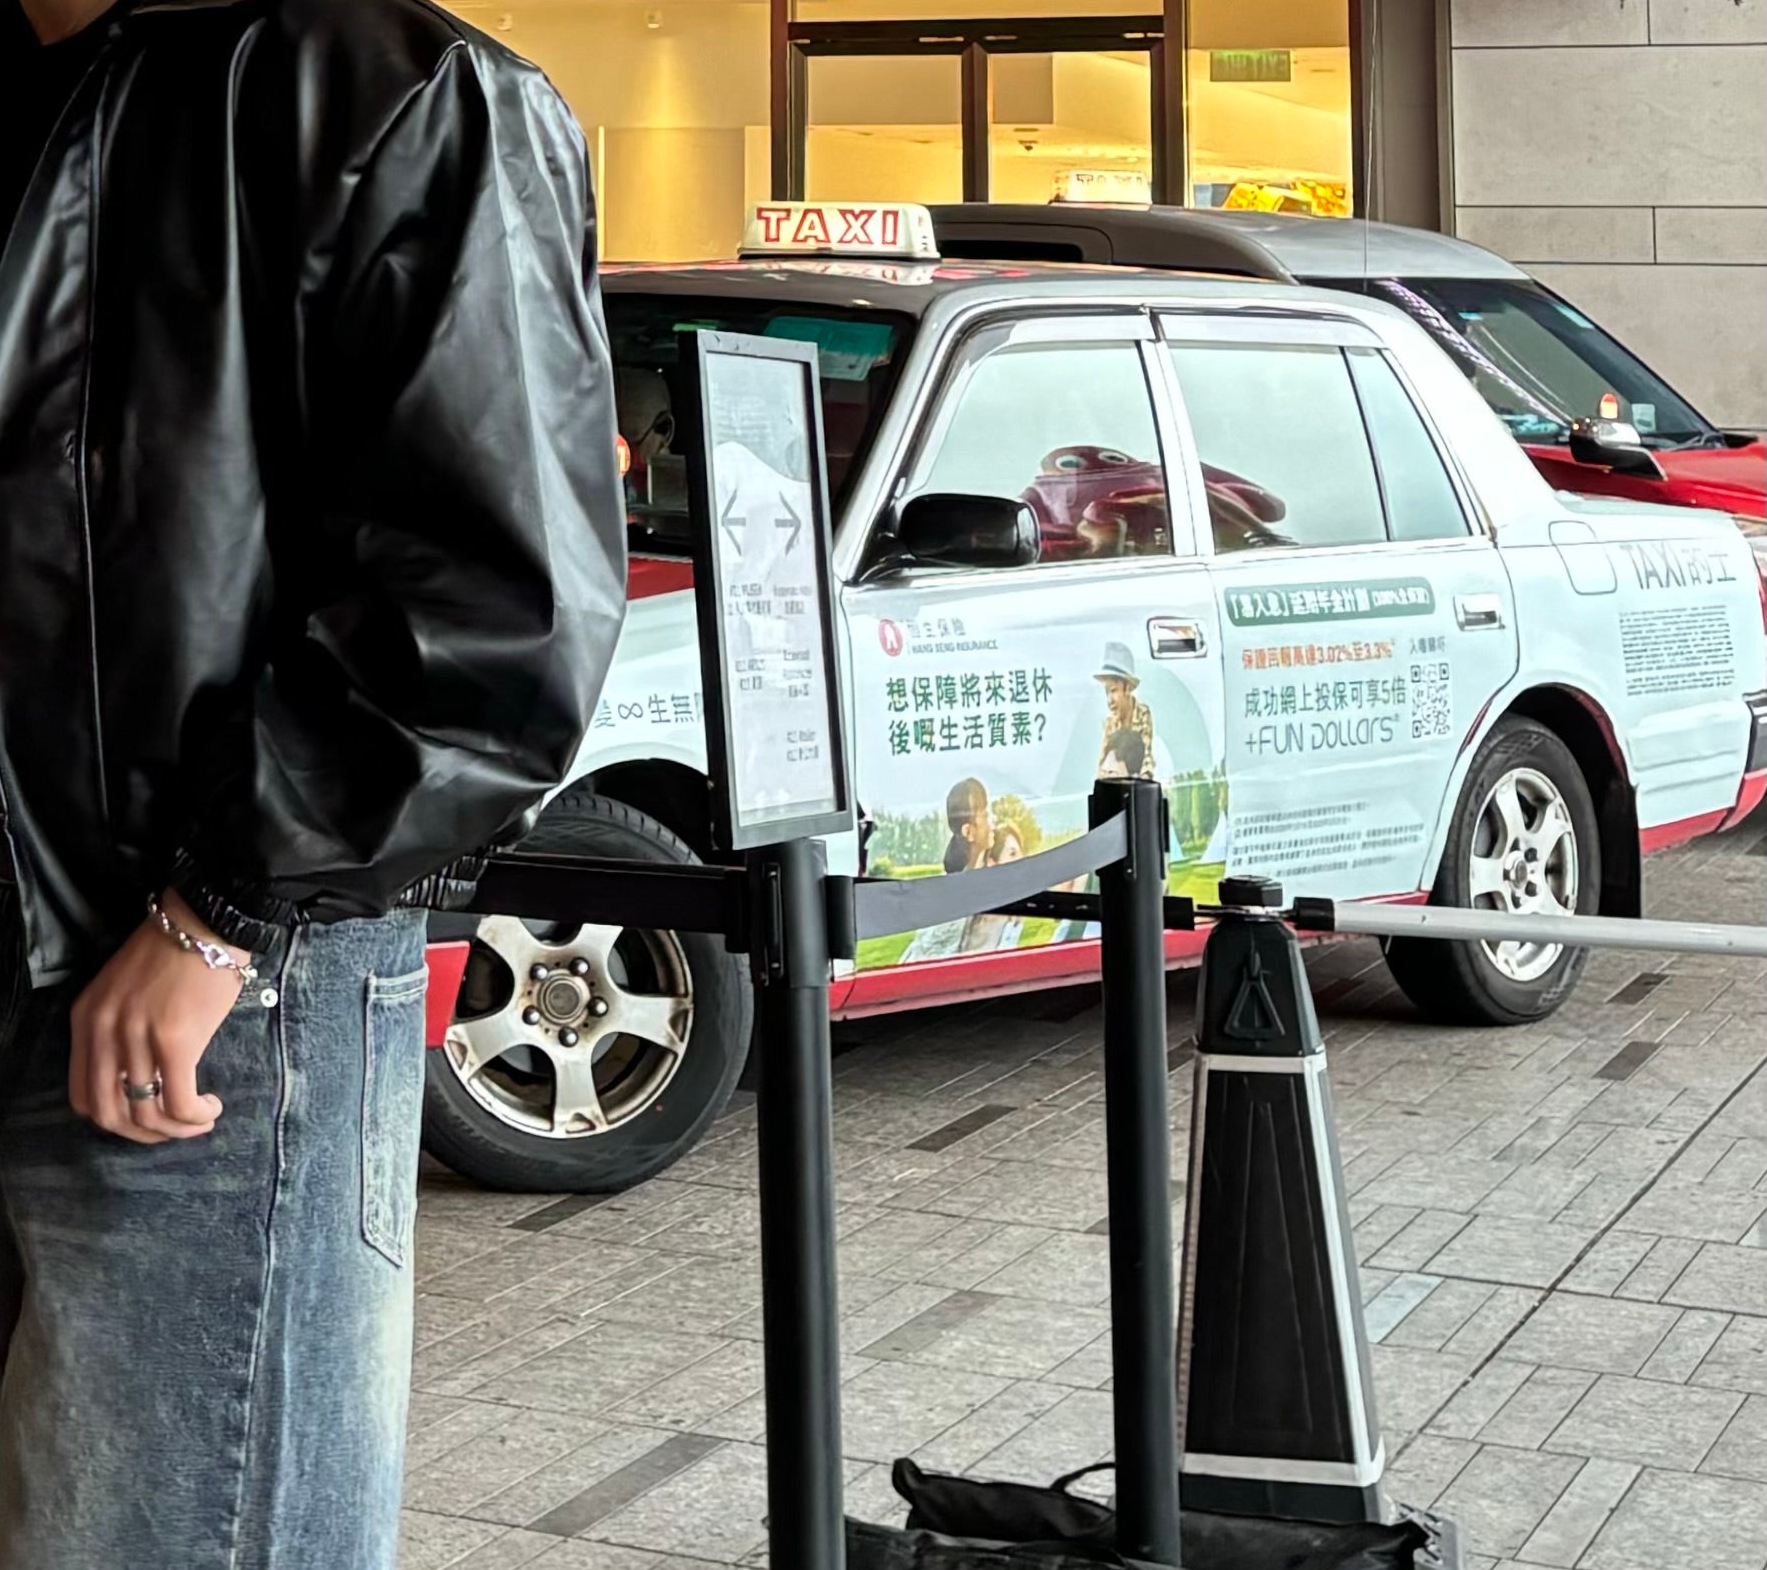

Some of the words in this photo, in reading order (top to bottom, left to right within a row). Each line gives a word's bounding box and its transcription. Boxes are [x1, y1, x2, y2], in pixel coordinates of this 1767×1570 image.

[756, 207, 900, 246] TAXI
[886, 668, 1054, 713] 想保障將來退休
[1245, 676, 1407, 718] 成功網上投保可享5倍
[1245, 722, 1304, 756] +FUN
